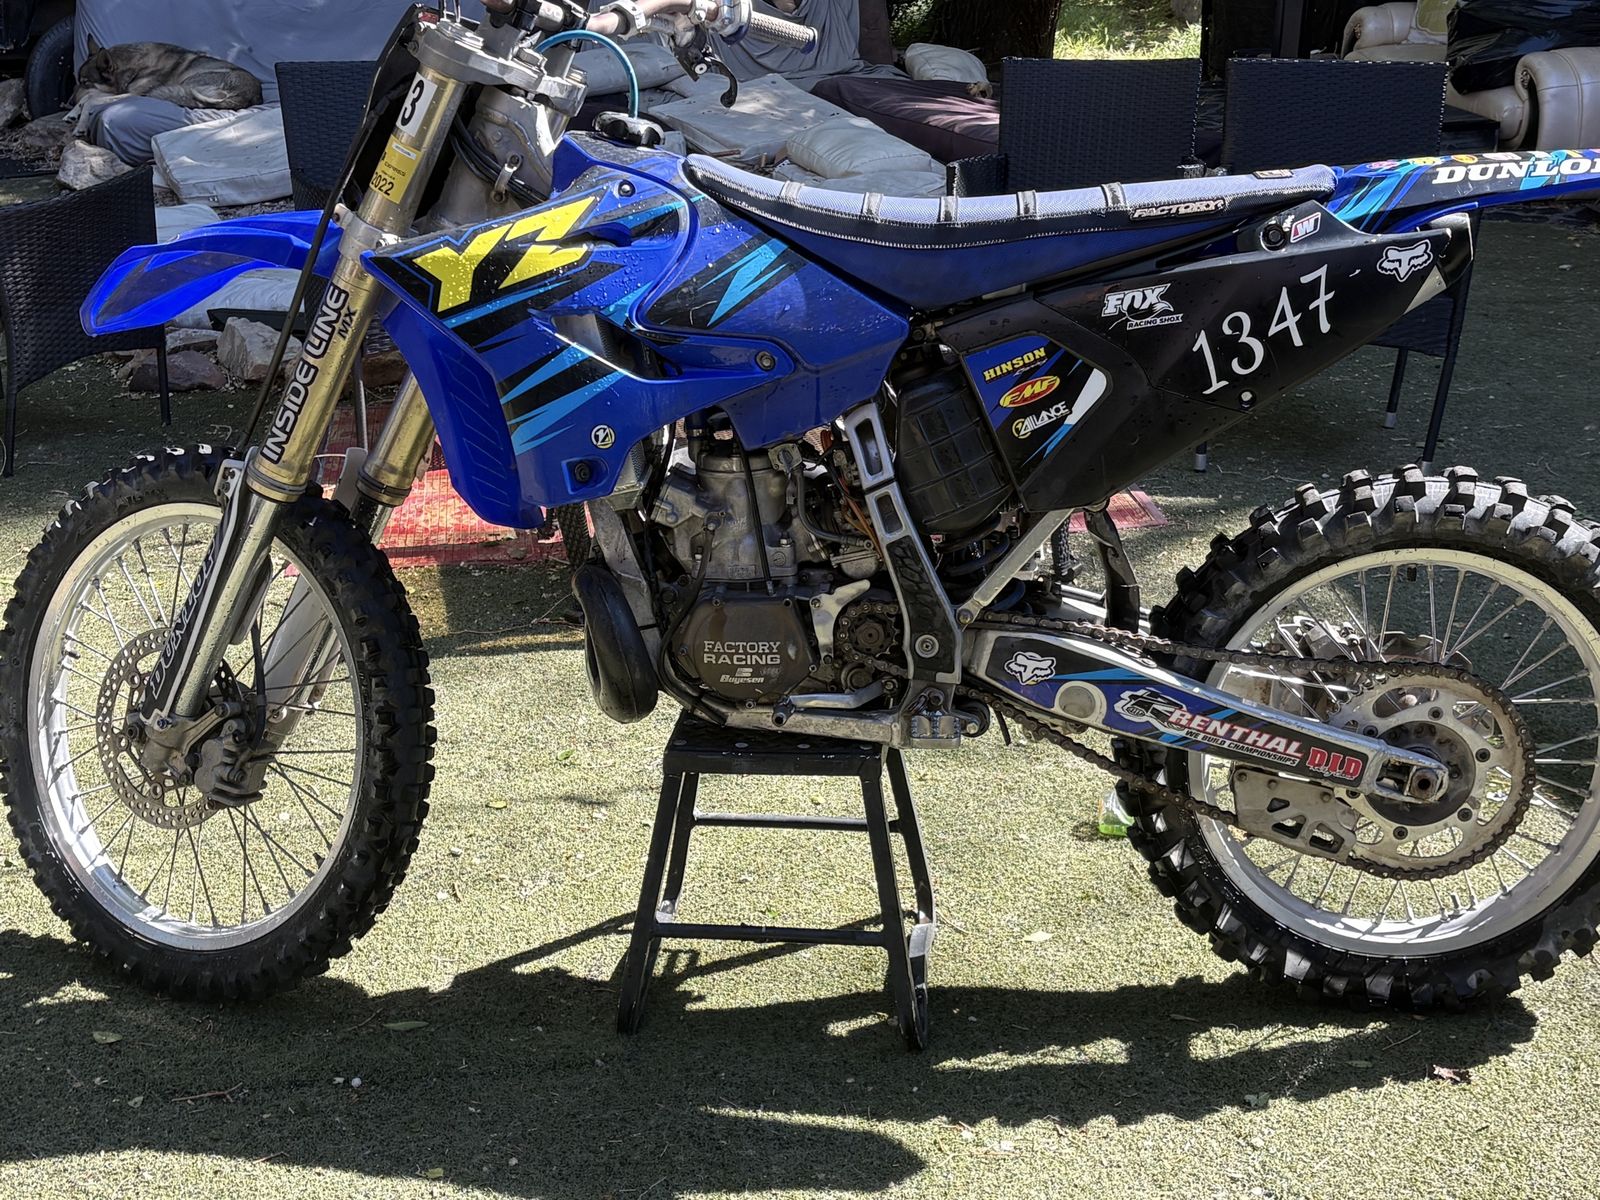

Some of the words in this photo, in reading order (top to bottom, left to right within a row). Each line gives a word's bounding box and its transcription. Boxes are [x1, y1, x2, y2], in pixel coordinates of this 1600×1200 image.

[400, 79, 425, 127] 3
[370, 171, 395, 197] 2022
[1132, 200, 1225, 219] FACTORY
[411, 196, 596, 313] YZ
[1102, 284, 1170, 317] FOX
[338, 308, 358, 340] MX
[1128, 318, 1158, 329] RACING
[1159, 315, 1181, 325] SHOX
[1192, 263, 1335, 395] 1347
[260, 362, 317, 464] INSIDE
[304, 286, 348, 358] LINE
[983, 347, 1047, 381] HINSON
[1001, 375, 1059, 408] FMF
[703, 640, 781, 653] FACTORY
[703, 653, 781, 665] RACING
[1168, 708, 1305, 758] RENTHAL
[1185, 729, 1200, 740] WE
[1201, 734, 1226, 747] BUILD
[1227, 742, 1298, 766] CHAMPIONSHIPS
